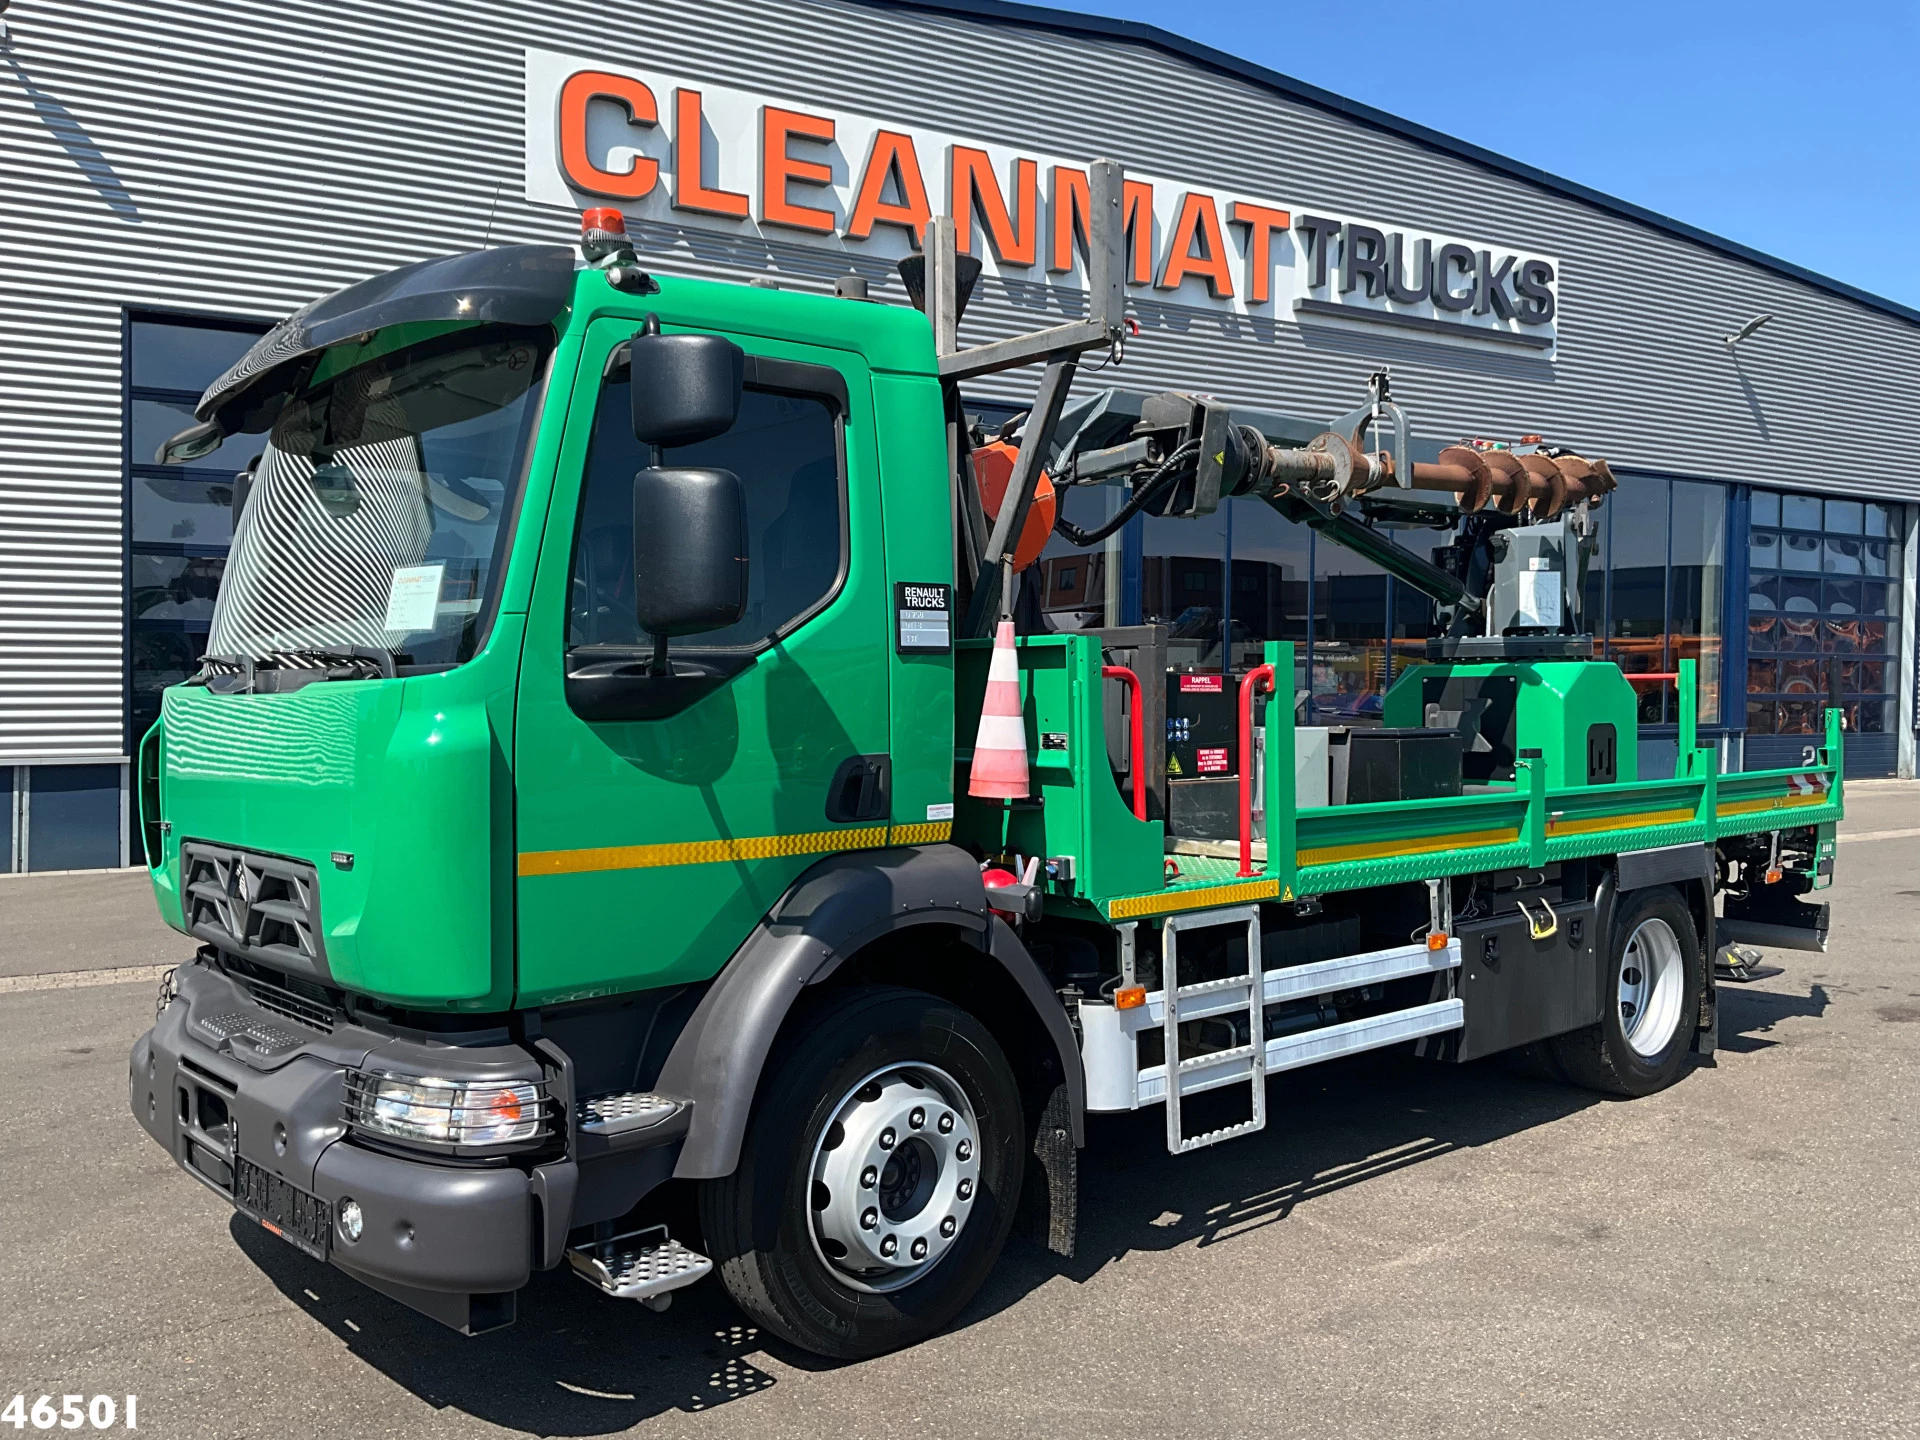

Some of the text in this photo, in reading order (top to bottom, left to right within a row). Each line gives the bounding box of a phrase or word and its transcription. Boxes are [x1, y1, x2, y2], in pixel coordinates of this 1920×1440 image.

[556, 69, 1556, 326] CLEANMAT TRUCKS
[904, 586, 945, 598] RENAULT
[904, 596, 946, 608] TRUCKS
[1191, 676, 1212, 684] RAPPEL
